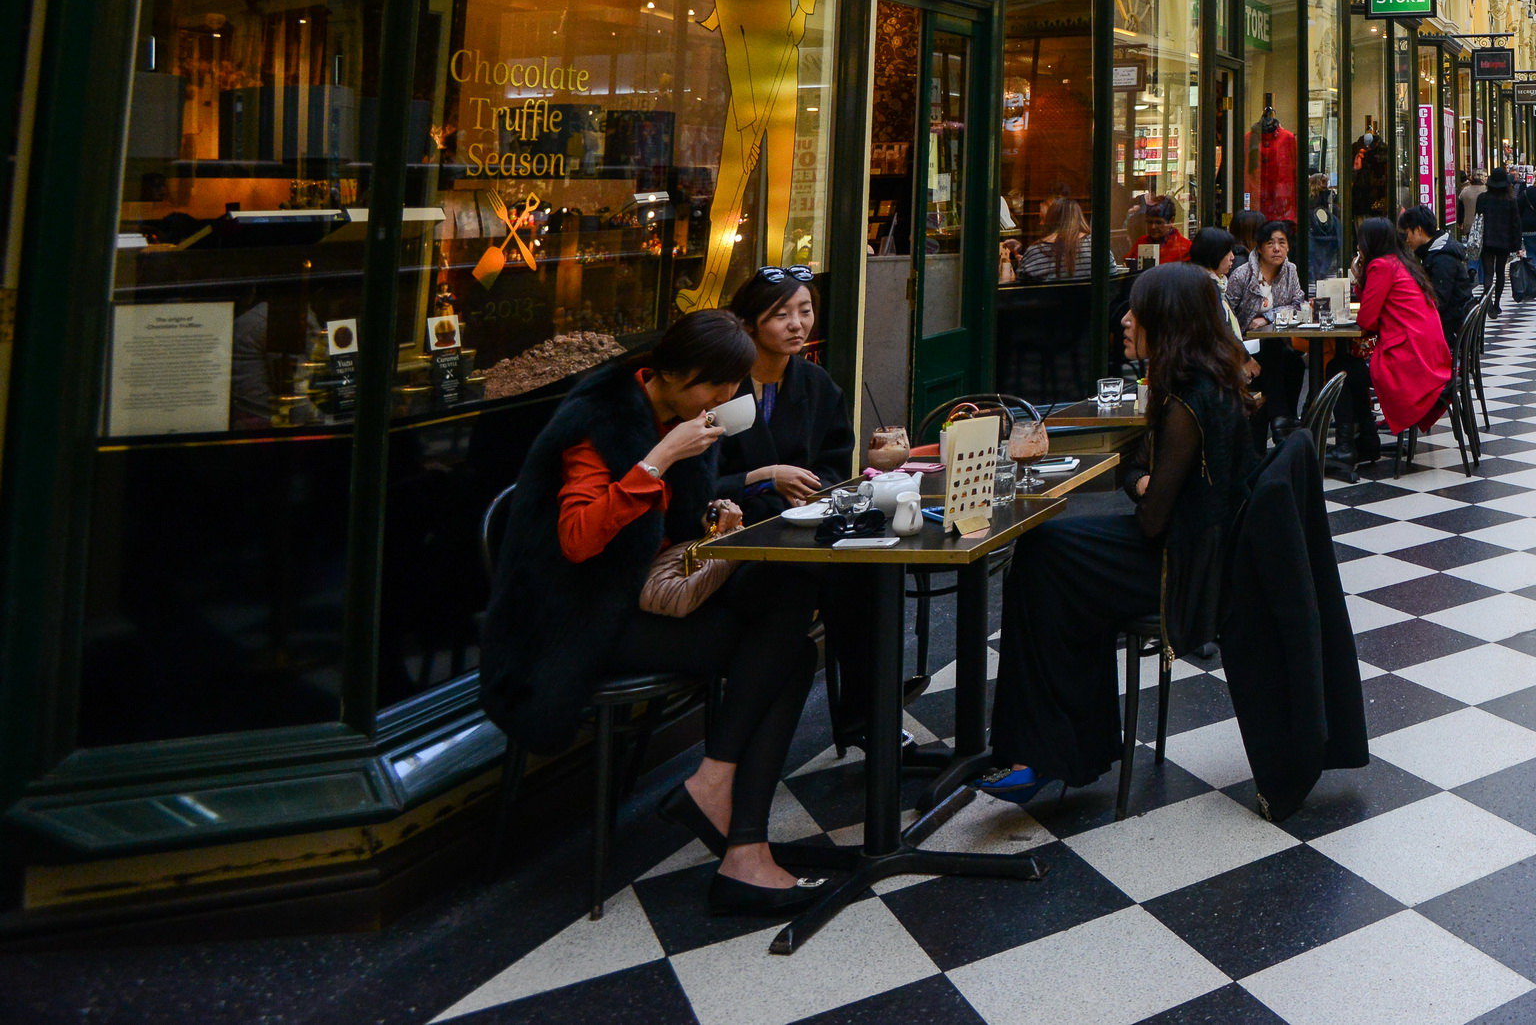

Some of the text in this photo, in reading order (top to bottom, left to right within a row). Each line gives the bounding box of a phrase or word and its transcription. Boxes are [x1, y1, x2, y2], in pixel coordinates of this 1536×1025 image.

[450, 49, 590, 92] Chocolate
[469, 97, 563, 142] Truffle
[1418, 107, 1430, 175] CLOSING
[466, 143, 566, 177] Season
